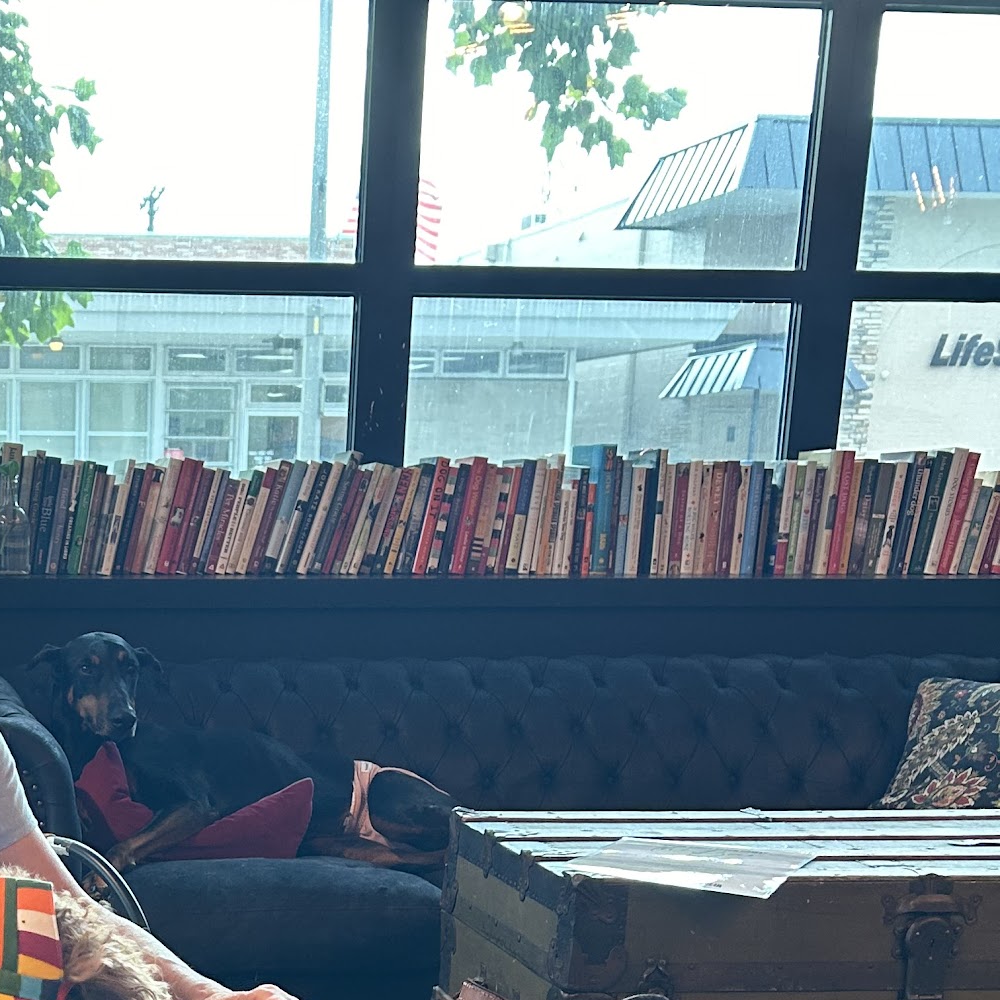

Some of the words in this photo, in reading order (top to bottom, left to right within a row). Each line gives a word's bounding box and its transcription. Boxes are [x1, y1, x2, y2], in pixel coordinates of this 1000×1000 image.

[318, 468, 328, 487] JON
[437, 460, 448, 482] DOG
[842, 470, 850, 491] LOST
[394, 466, 413, 499] SCENT
[472, 475, 481, 490] Dog
[713, 472, 722, 504] DEWEY
[911, 468, 923, 500] thunder
[950, 476, 959, 491] DOG
[225, 493, 234, 506] Pet
[310, 489, 321, 510] KATZ
[432, 486, 442, 501] ON
[429, 505, 438, 518] IT
[906, 500, 917, 516] dog
[38, 507, 51, 532] Blue
[215, 508, 230, 541] Miracles
